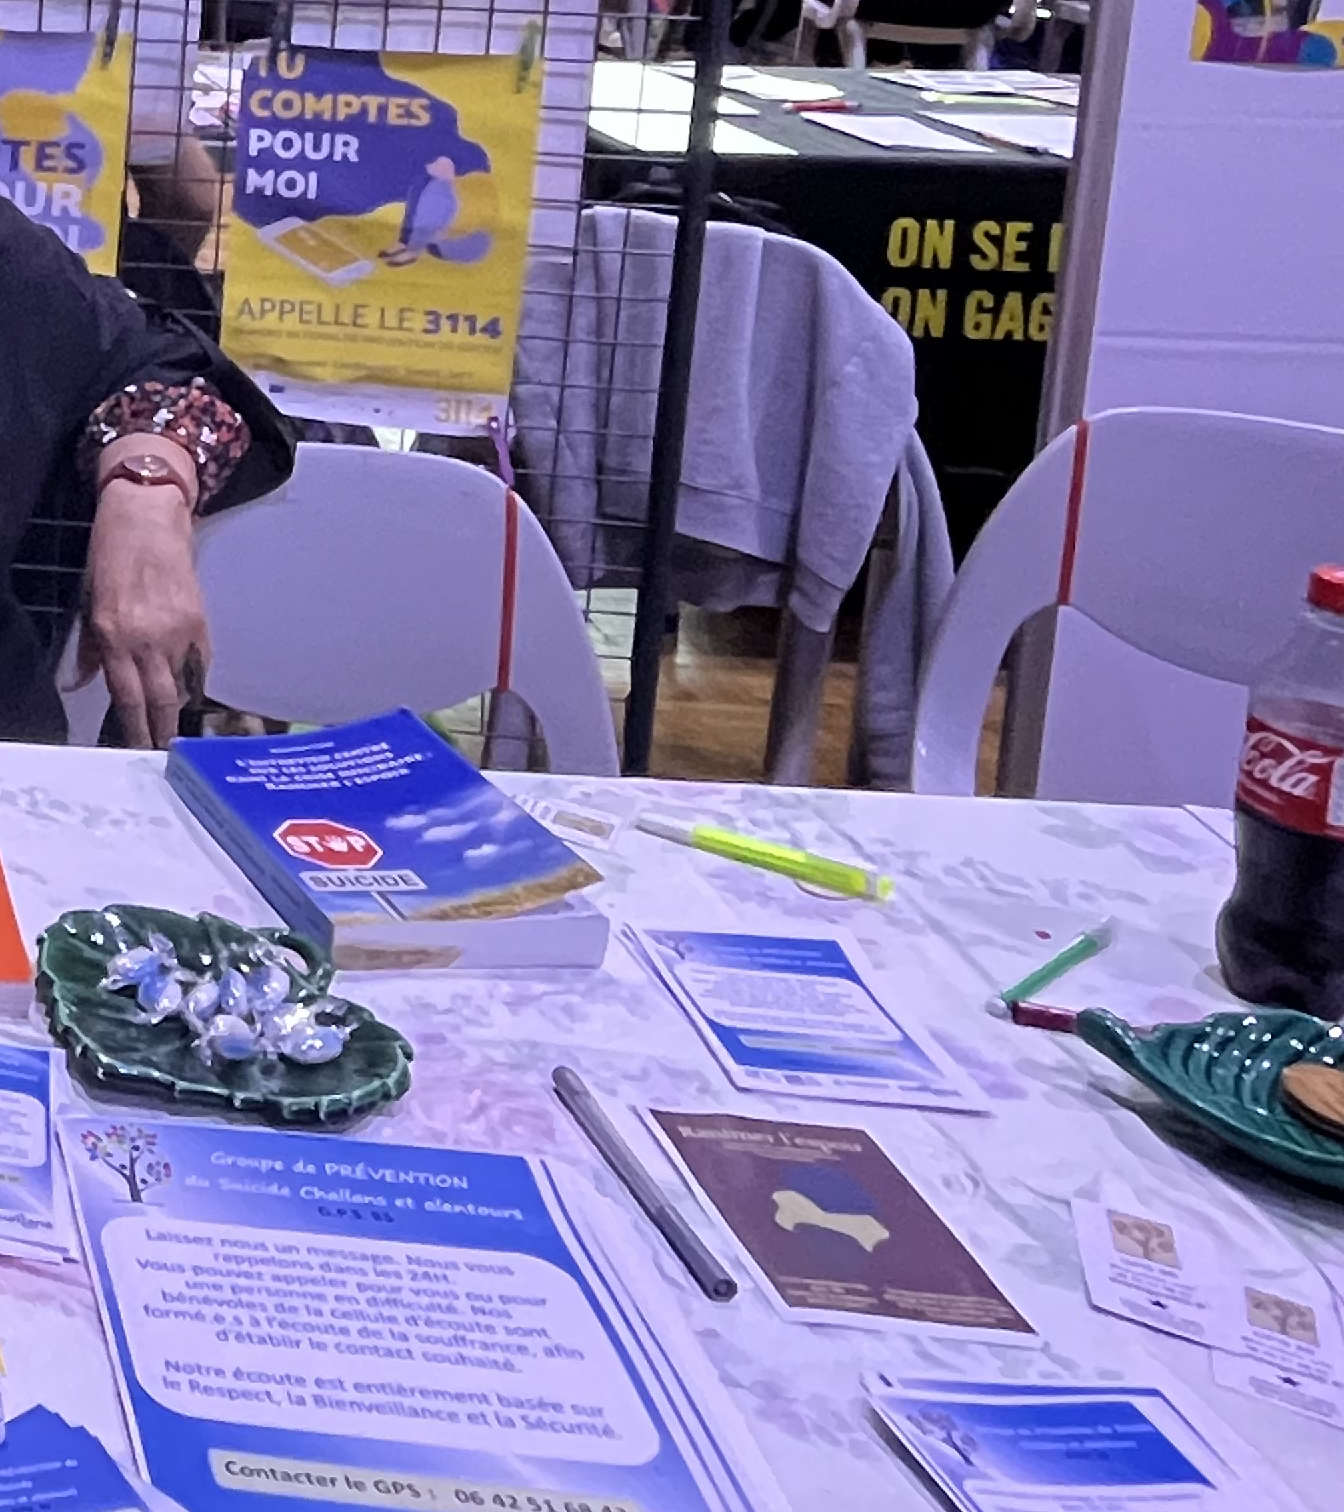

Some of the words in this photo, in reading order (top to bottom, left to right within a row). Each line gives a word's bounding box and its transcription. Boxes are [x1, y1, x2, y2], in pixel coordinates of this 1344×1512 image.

[249, 89, 431, 126] COMPTES
[248, 128, 360, 162] POUR
[245, 168, 318, 199] MOI
[886, 217, 956, 269] ON
[969, 220, 1034, 272] SE
[236, 296, 370, 328] APPELLE
[378, 307, 414, 331] LE
[422, 309, 503, 339] 3114
[309, 873, 419, 888] SUICIDE
[210, 1150, 284, 1173] Groupe
[291, 1159, 317, 1176] de
[324, 1161, 469, 1190] PRÉVENTION
[424, 1198, 523, 1221] alentours
[145, 1229, 213, 1246] Laissez
[220, 1238, 269, 1252] nous
[274, 1243, 300, 1255] un
[192, 1264, 264, 1281] pouvez
[271, 1273, 347, 1287] appeler
[357, 1282, 403, 1294] pour
[409, 1287, 459, 1300] vous
[213, 1253, 314, 1271] rappelons
[319, 1262, 368, 1277] dans
[185, 1281, 223, 1292] une
[230, 1284, 327, 1303] personne
[334, 1294, 360, 1305] en
[162, 1289, 268, 1312] bénévoles
[274, 1303, 298, 1314] de
[305, 1304, 324, 1318] la
[330, 1308, 399, 1325] cellule
[404, 1315, 497, 1334] d'écoute
[307, 1337, 327, 1351] le
[334, 1342, 415, 1361] contact
[357, 1327, 384, 1340] de
[389, 1327, 409, 1342] la
[164, 1359, 226, 1378] Notre
[233, 1366, 307, 1387] écoute
[314, 1376, 348, 1392] est
[353, 1382, 493, 1406] entièrement
[286, 1390, 306, 1407] la
[311, 1393, 460, 1423] Bienveillance
[467, 1411, 492, 1427] et
[494, 1410, 516, 1429] la
[224, 1460, 339, 1489] Contacter
[344, 1475, 367, 1493] le
[372, 1478, 422, 1500] GPS
[454, 1488, 485, 1506] 06
[492, 1494, 519, 1511] 42
